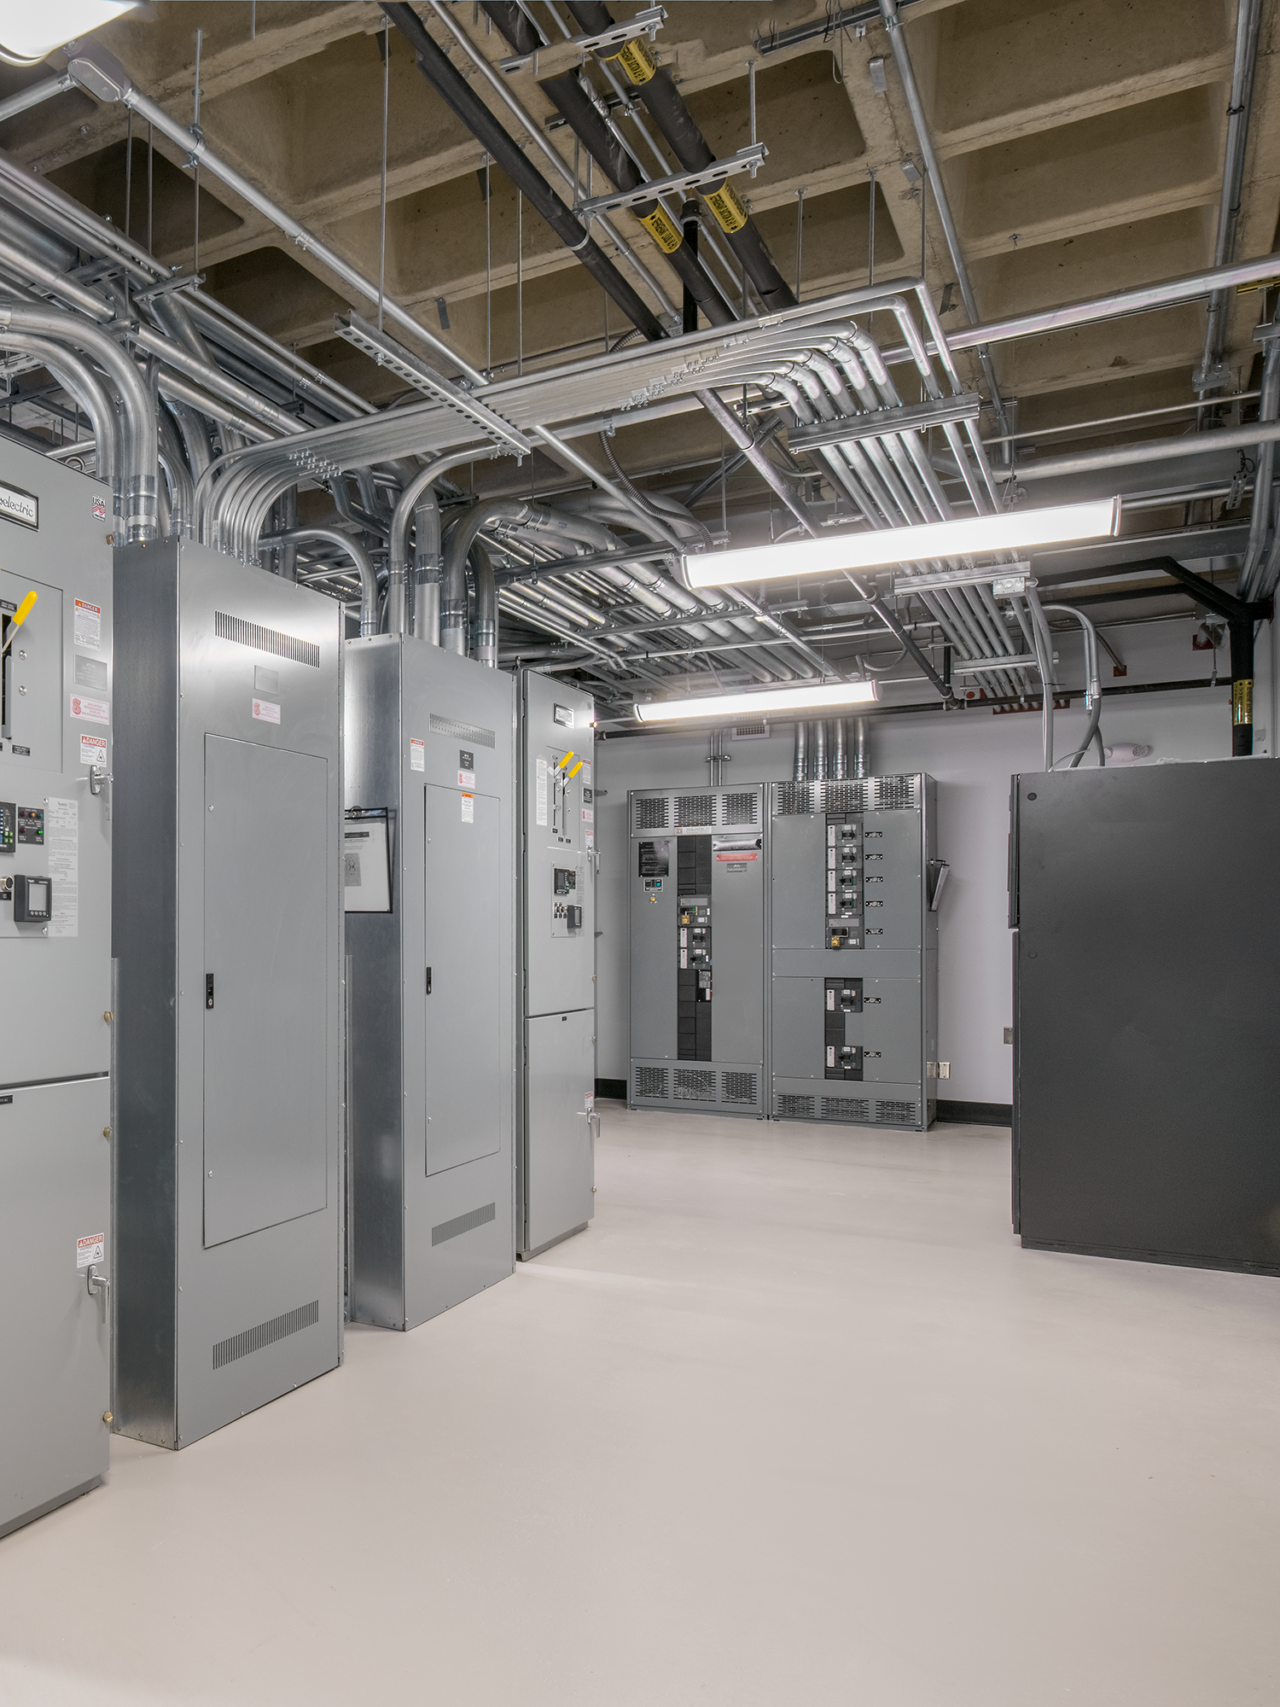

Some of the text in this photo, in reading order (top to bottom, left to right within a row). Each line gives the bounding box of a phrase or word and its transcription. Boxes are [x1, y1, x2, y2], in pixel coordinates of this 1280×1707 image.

[92, 496, 105, 507] USA
[81, 602, 98, 612] DANGER
[86, 737, 106, 747] DANGER
[83, 1236, 103, 1246] DANGER
